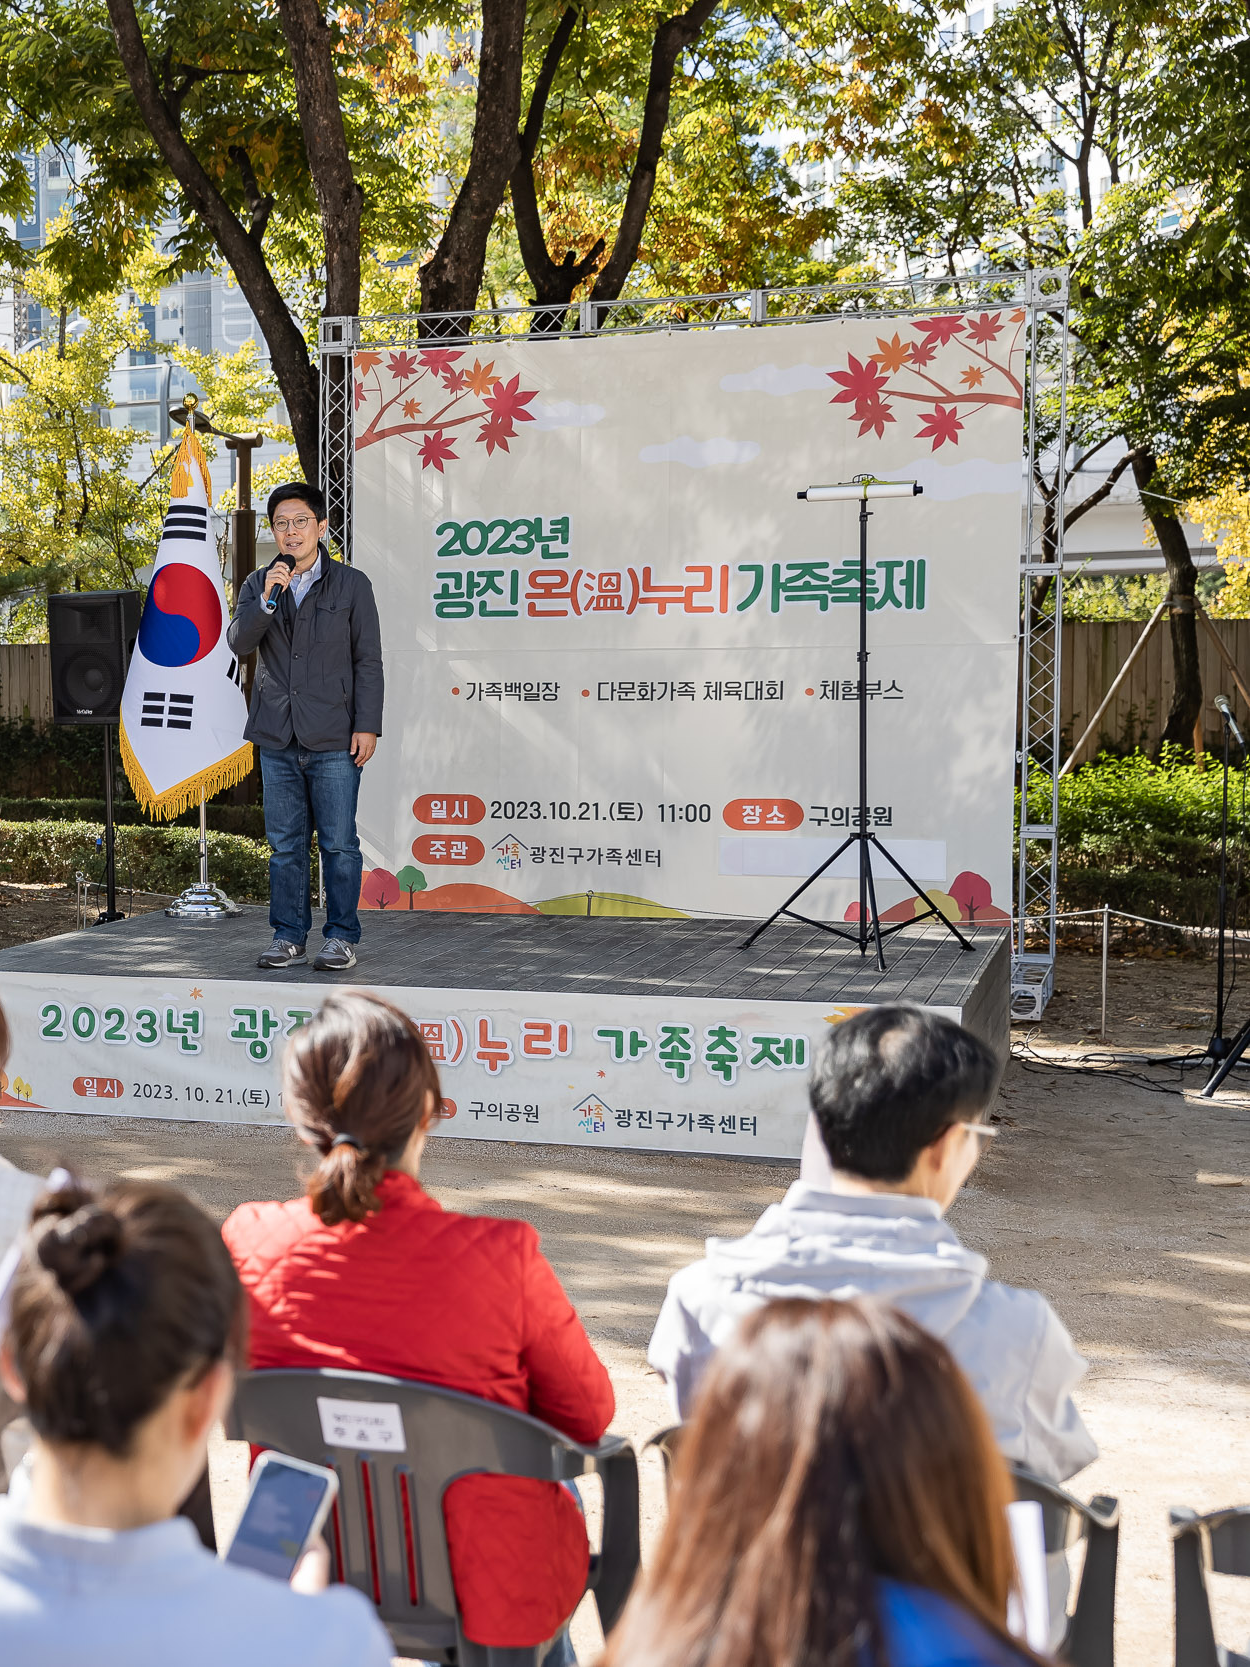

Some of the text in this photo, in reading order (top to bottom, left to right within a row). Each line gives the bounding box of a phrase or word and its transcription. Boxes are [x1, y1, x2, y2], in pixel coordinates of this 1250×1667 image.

[436, 517, 569, 559] 2023년
[433, 569, 519, 619] 광진
[737, 559, 926, 613] 가족축제
[466, 682, 560, 701] 가족백일장
[598, 680, 784, 701] 다문화가족 체육대회
[819, 679, 904, 700] 체험부스
[430, 800, 892, 827] 일시 2023.10.21.(토) 11:00 장소 구의공원
[429, 840, 662, 867] 주관 광진구가족센터
[41, 1004, 200, 1051] 2023년
[597, 1025, 805, 1082] 가족축제
[83, 1078, 118, 1098] 일시
[133, 1083, 178, 1101] 2023.
[185, 1086, 209, 1103] 10.
[468, 1101, 540, 1124] 구의공원
[614, 1109, 758, 1136] 광진구가족센터
